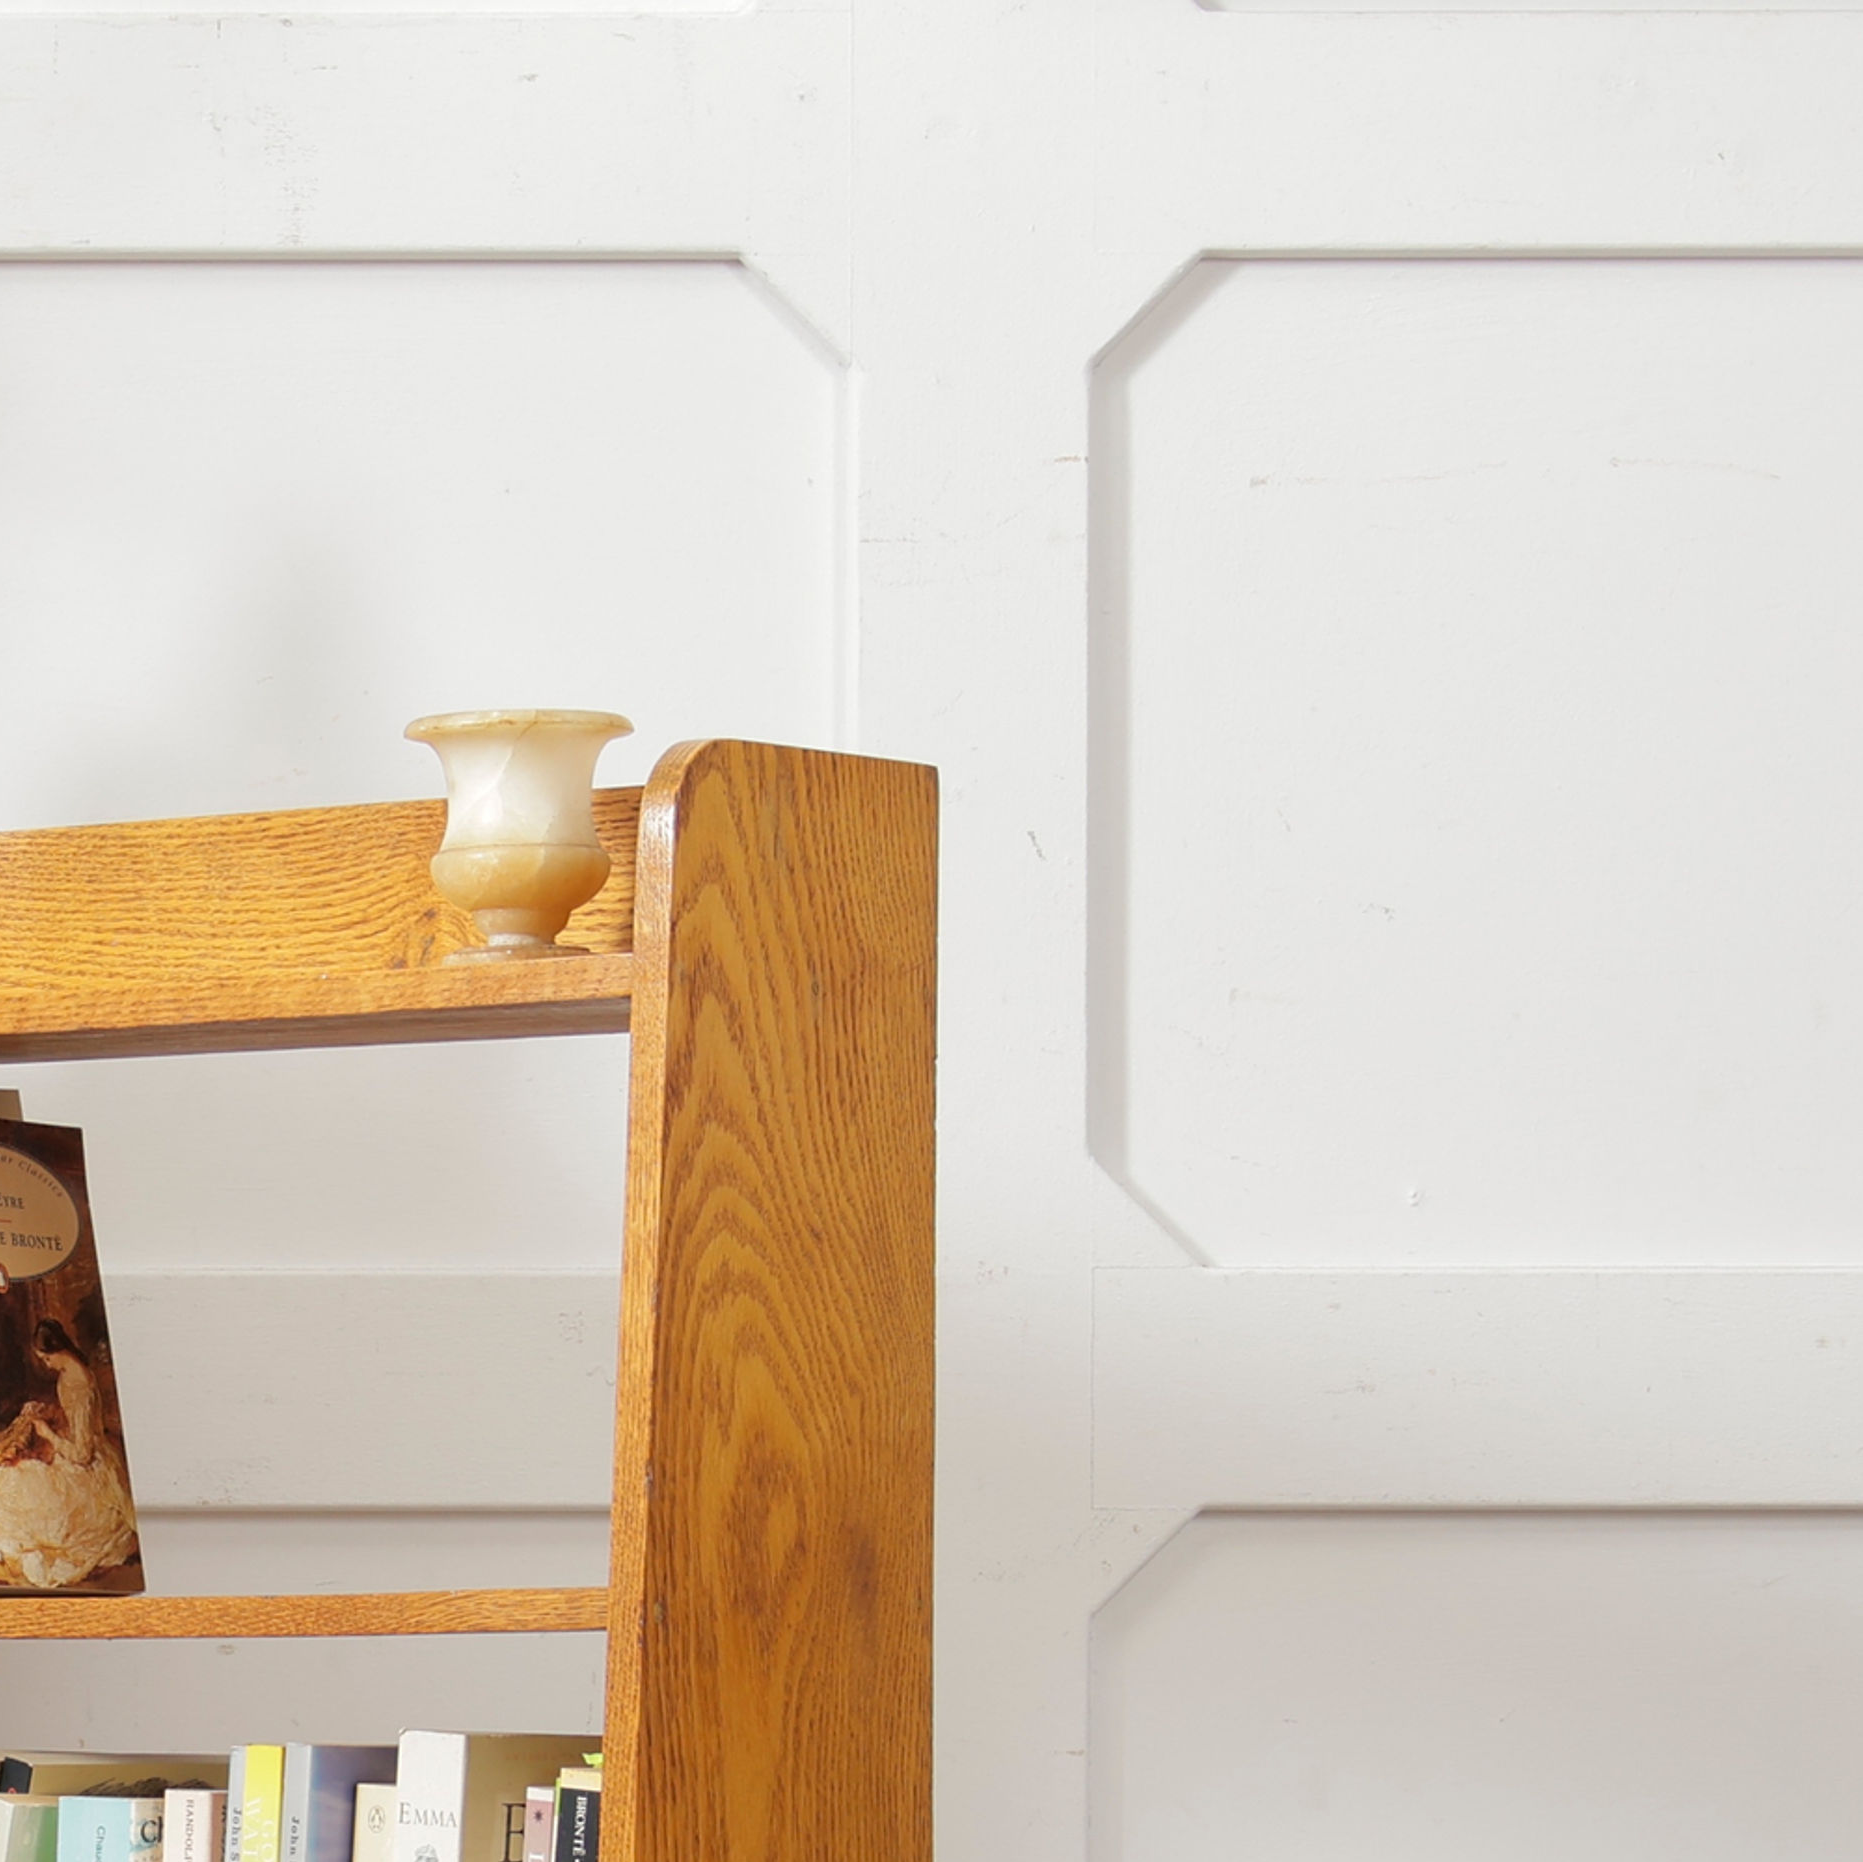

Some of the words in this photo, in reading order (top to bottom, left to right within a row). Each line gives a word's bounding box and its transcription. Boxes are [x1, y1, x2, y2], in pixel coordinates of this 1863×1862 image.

[18, 1160, 64, 1198] Classics
[230, 1807, 243, 1846] John
[399, 1802, 457, 1828] EMMA
[289, 1816, 299, 1855] John
